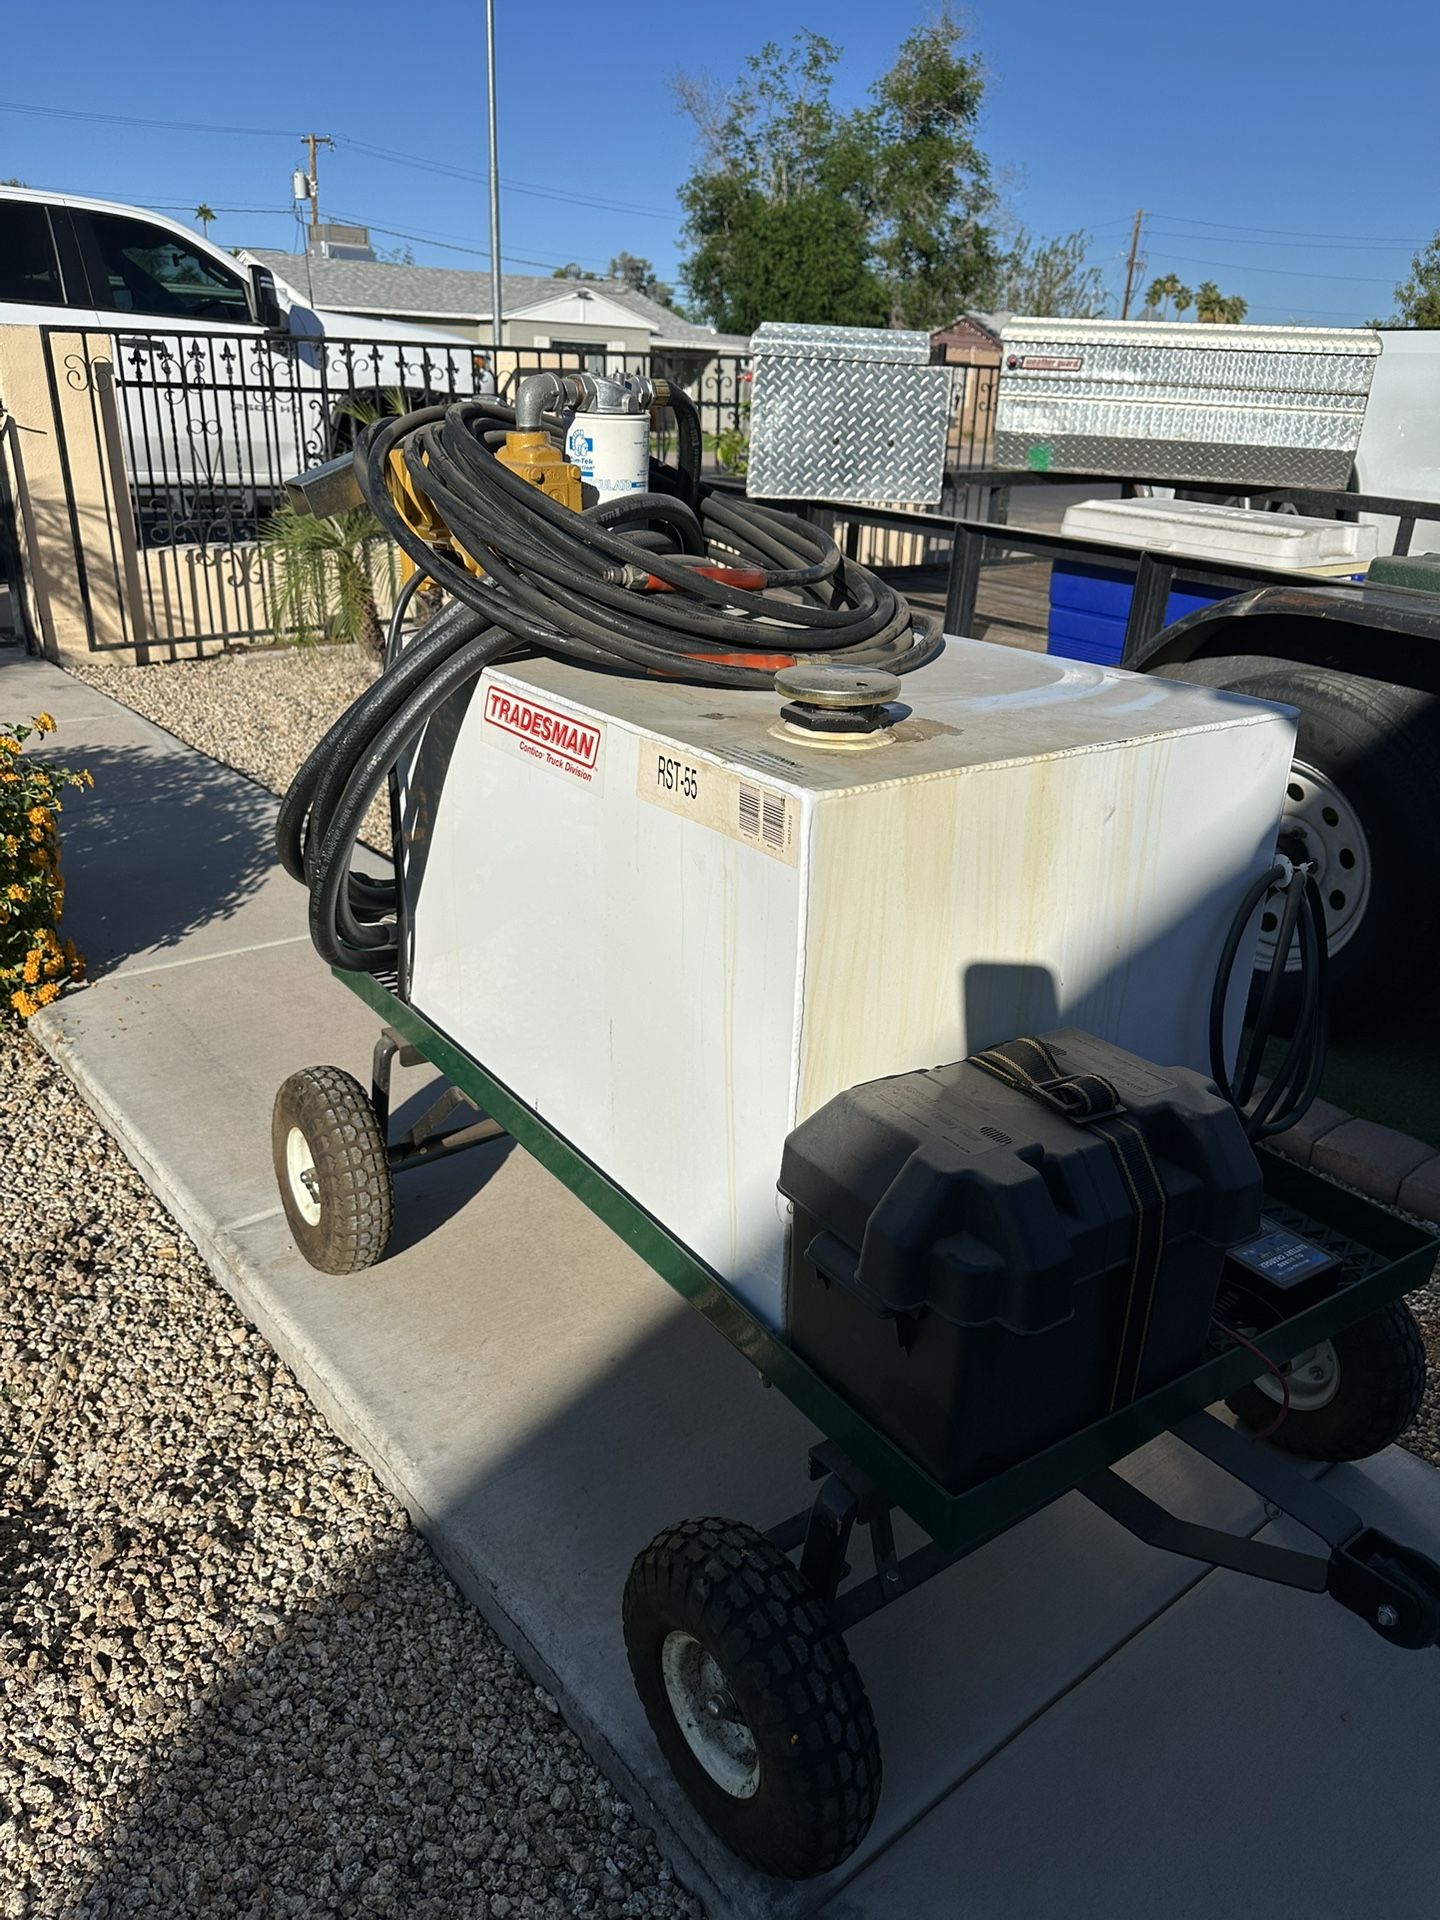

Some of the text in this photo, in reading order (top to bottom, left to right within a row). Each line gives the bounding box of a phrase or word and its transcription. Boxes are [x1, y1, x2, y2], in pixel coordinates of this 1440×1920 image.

[490, 693, 594, 759] TRADESMAN
[546, 753, 563, 768] Truck
[564, 762, 592, 781] Division
[658, 755, 698, 799] RST-55
[336, 808, 352, 829] HOSE
